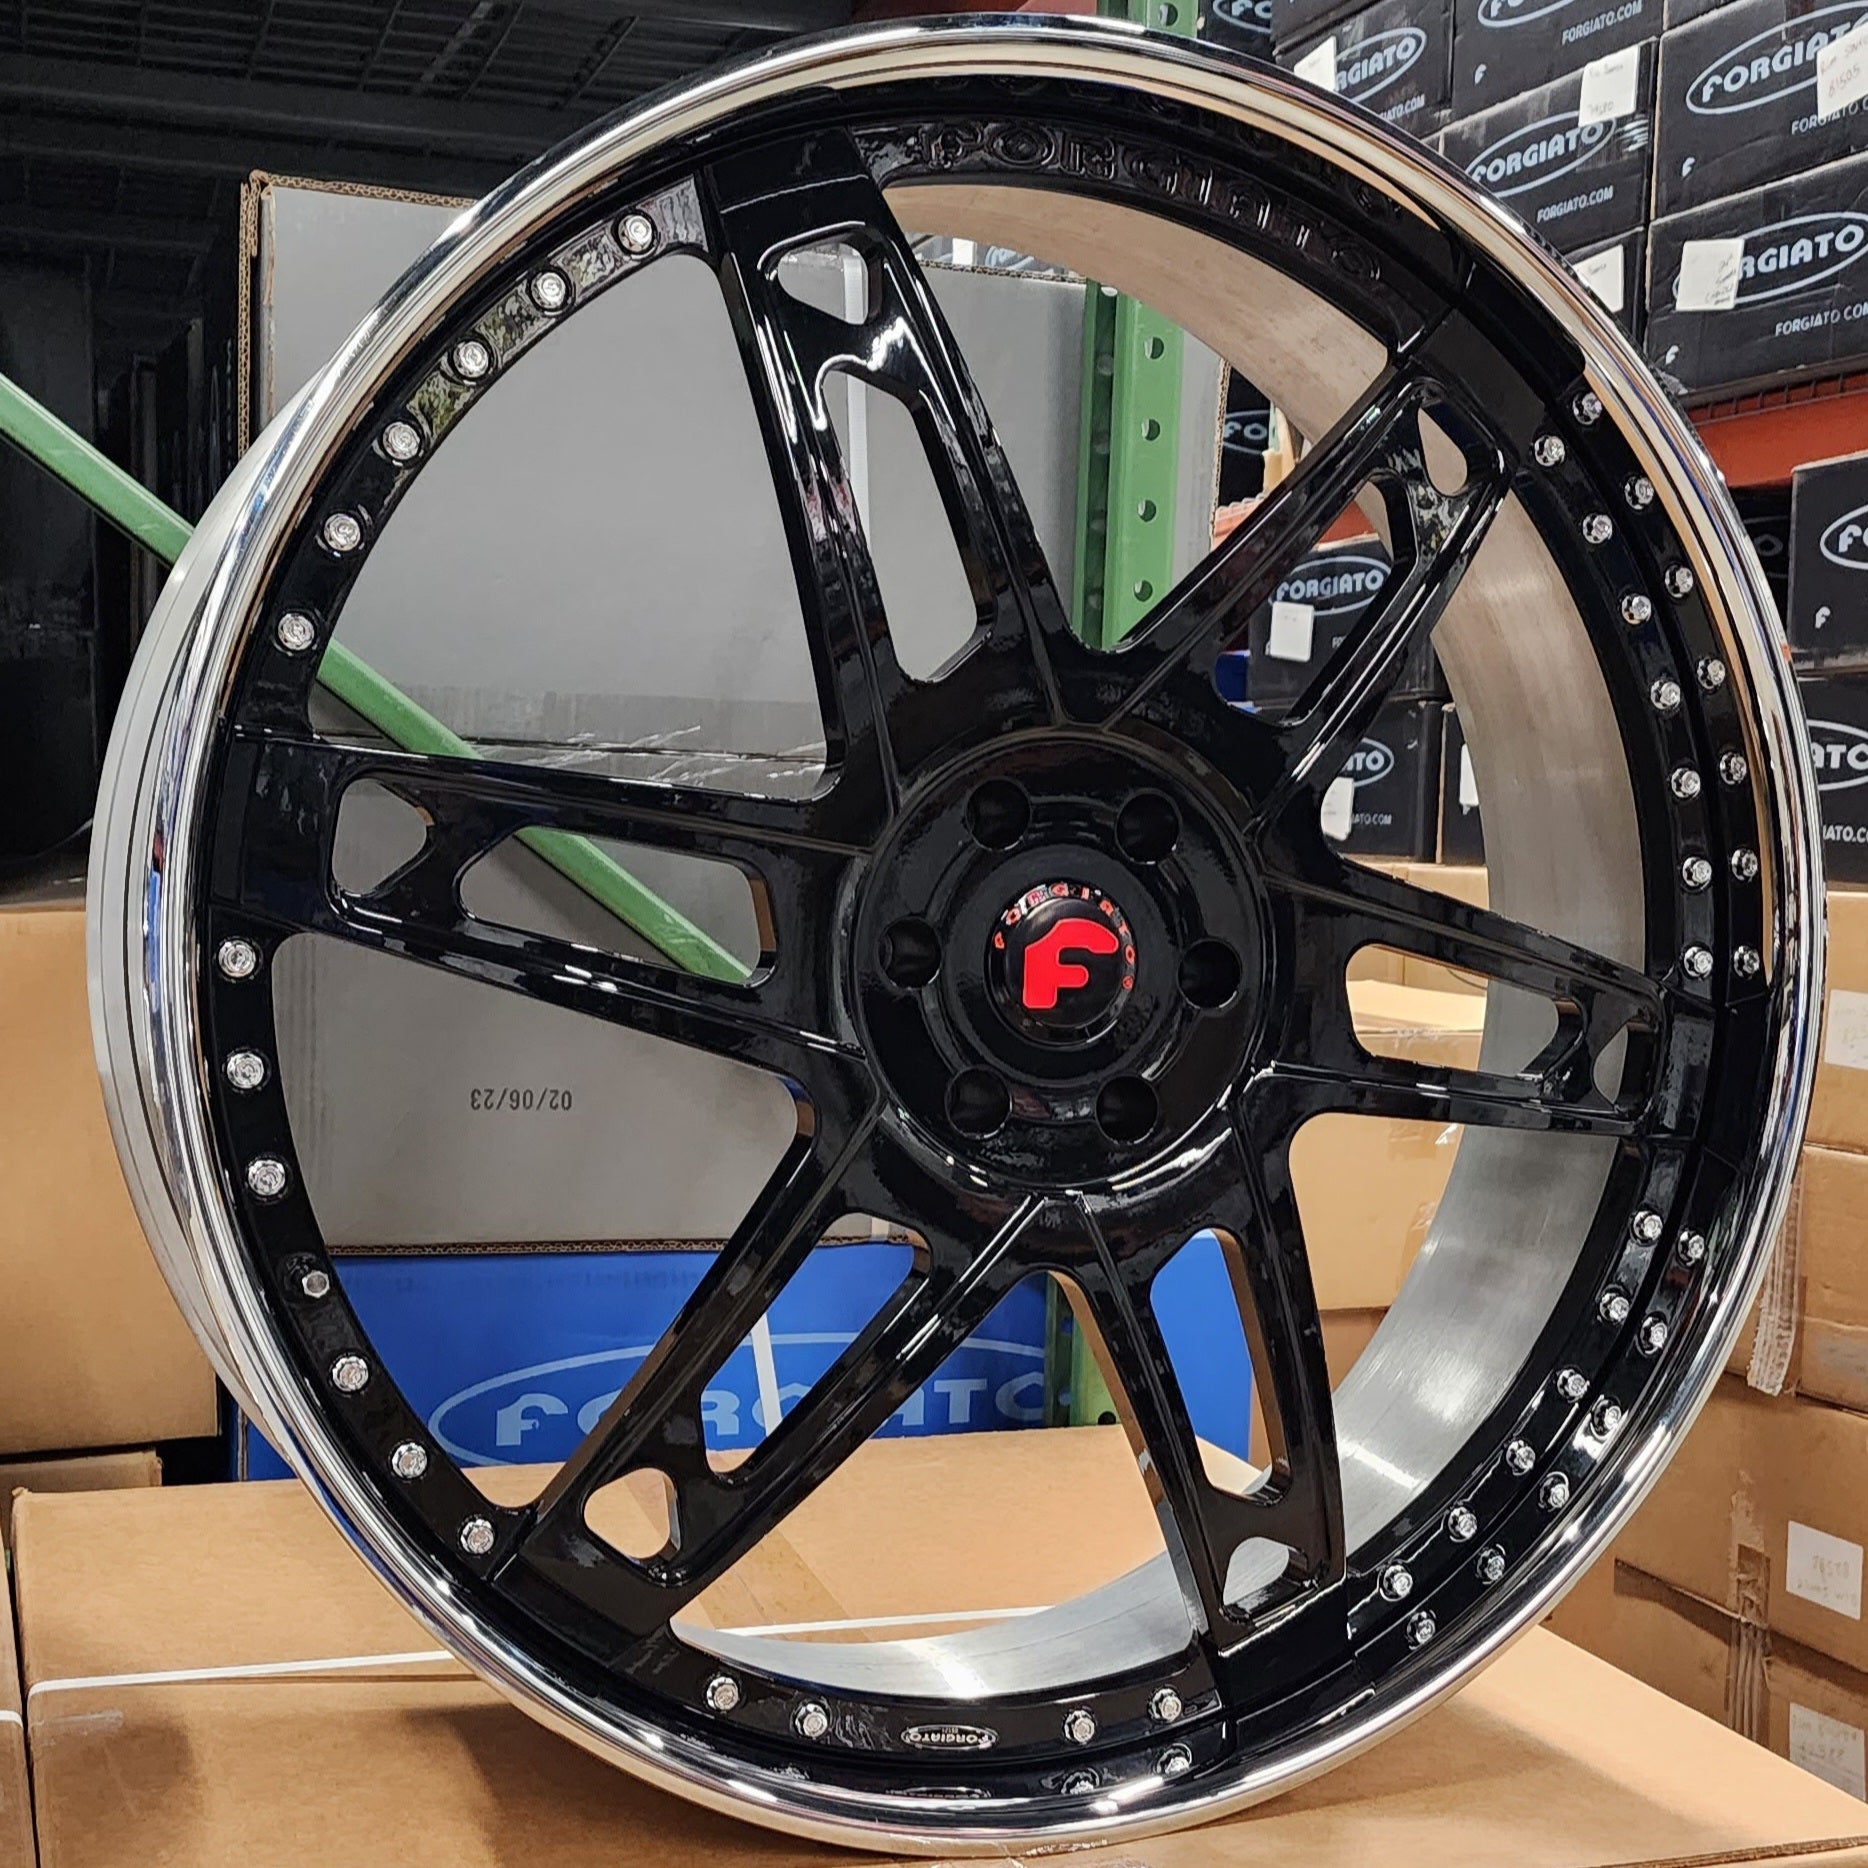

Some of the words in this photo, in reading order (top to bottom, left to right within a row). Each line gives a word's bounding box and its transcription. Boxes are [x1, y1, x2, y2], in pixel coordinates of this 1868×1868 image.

[1562, 0, 1643, 45] FORGIATO.COM
[1702, 12, 1868, 103] FORGIAT
[1471, 122, 1604, 183] FORGIATO
[1537, 185, 1614, 224] FORGIATO.COM
[1738, 224, 1865, 281] RGIATO
[1276, 568, 1384, 602] FORGIATO
[1023, 917, 1119, 1009] F
